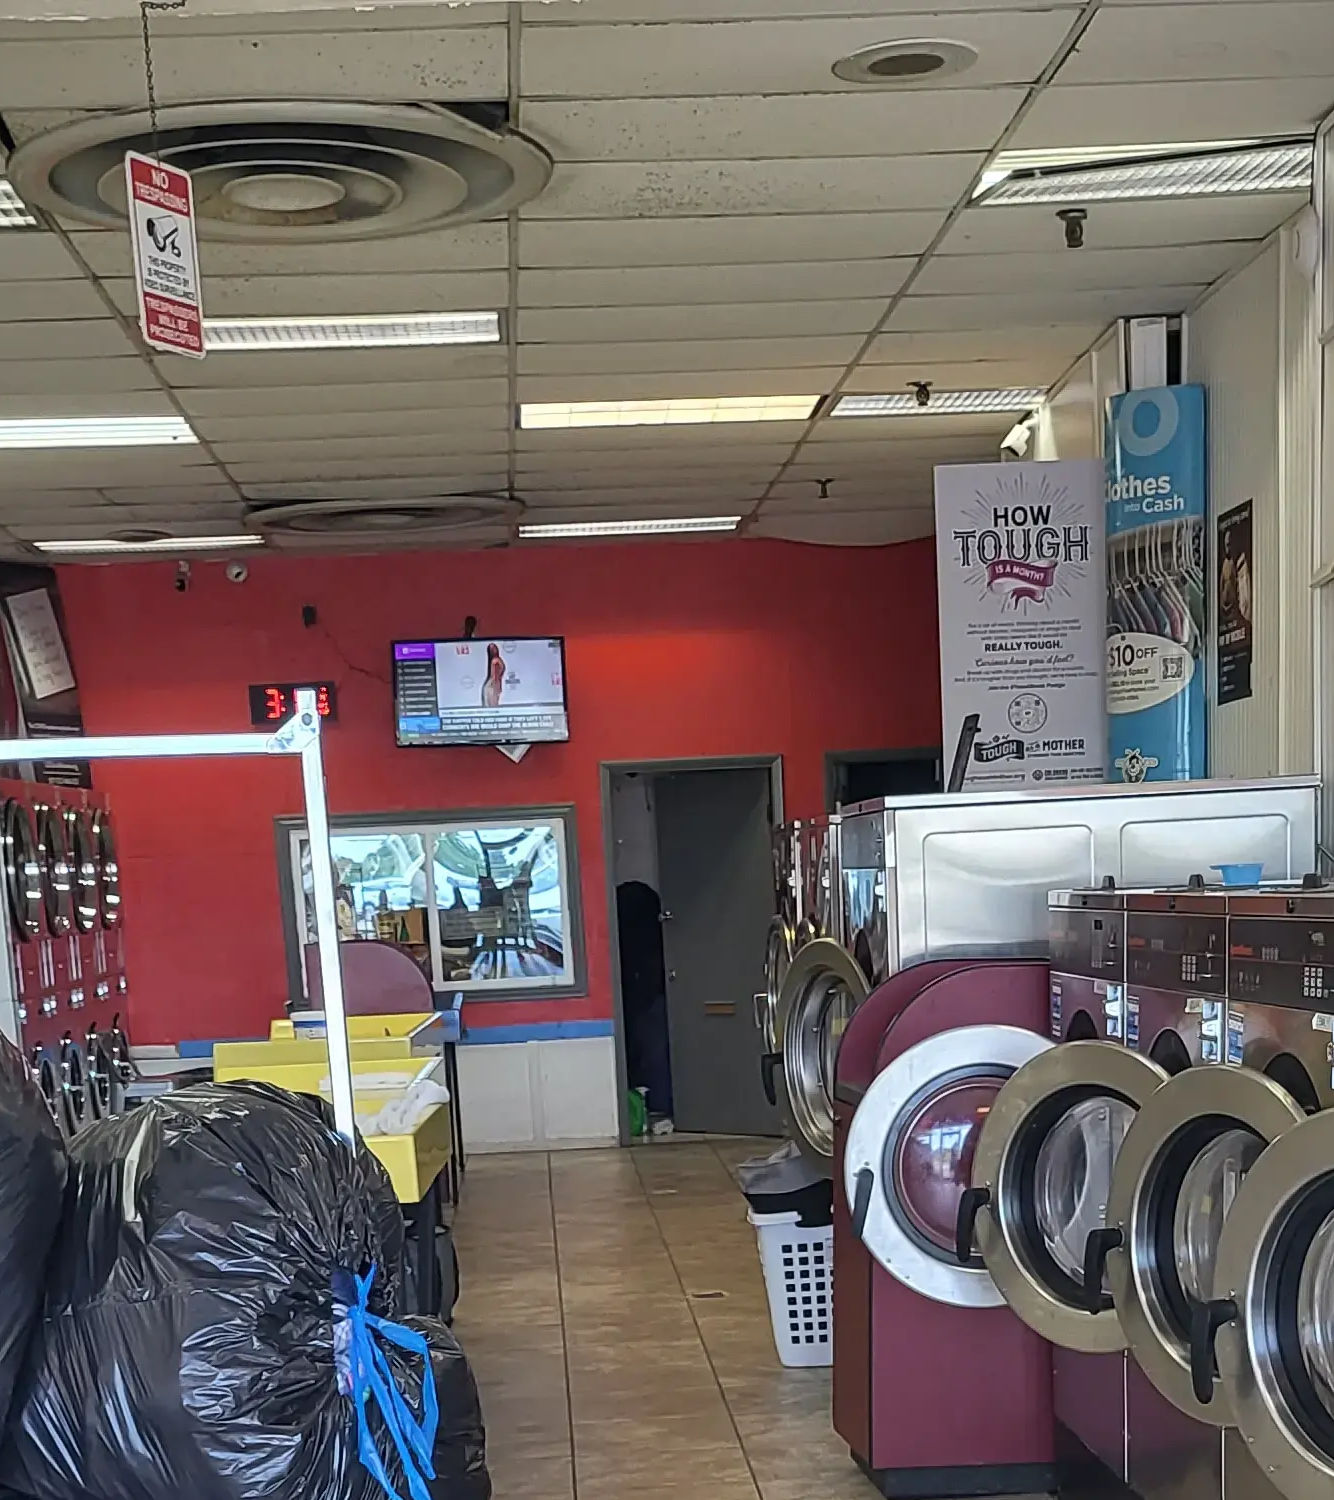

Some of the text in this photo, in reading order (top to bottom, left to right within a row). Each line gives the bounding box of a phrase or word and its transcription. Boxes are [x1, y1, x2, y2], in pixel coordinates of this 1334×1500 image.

[151, 168, 169, 189] NO
[1105, 475, 1171, 502] lothes
[1142, 494, 1185, 513] Cash
[993, 505, 1051, 527] HOW
[953, 525, 1089, 567] TOUGH
[995, 564, 1045, 581] IS A MONTH?
[984, 639, 1063, 652] REALLY TOUGH.
[1108, 644, 1159, 668] $10 OFF
[981, 743, 1018, 760] TOUGH
[1042, 739, 1085, 751] MOTHER
